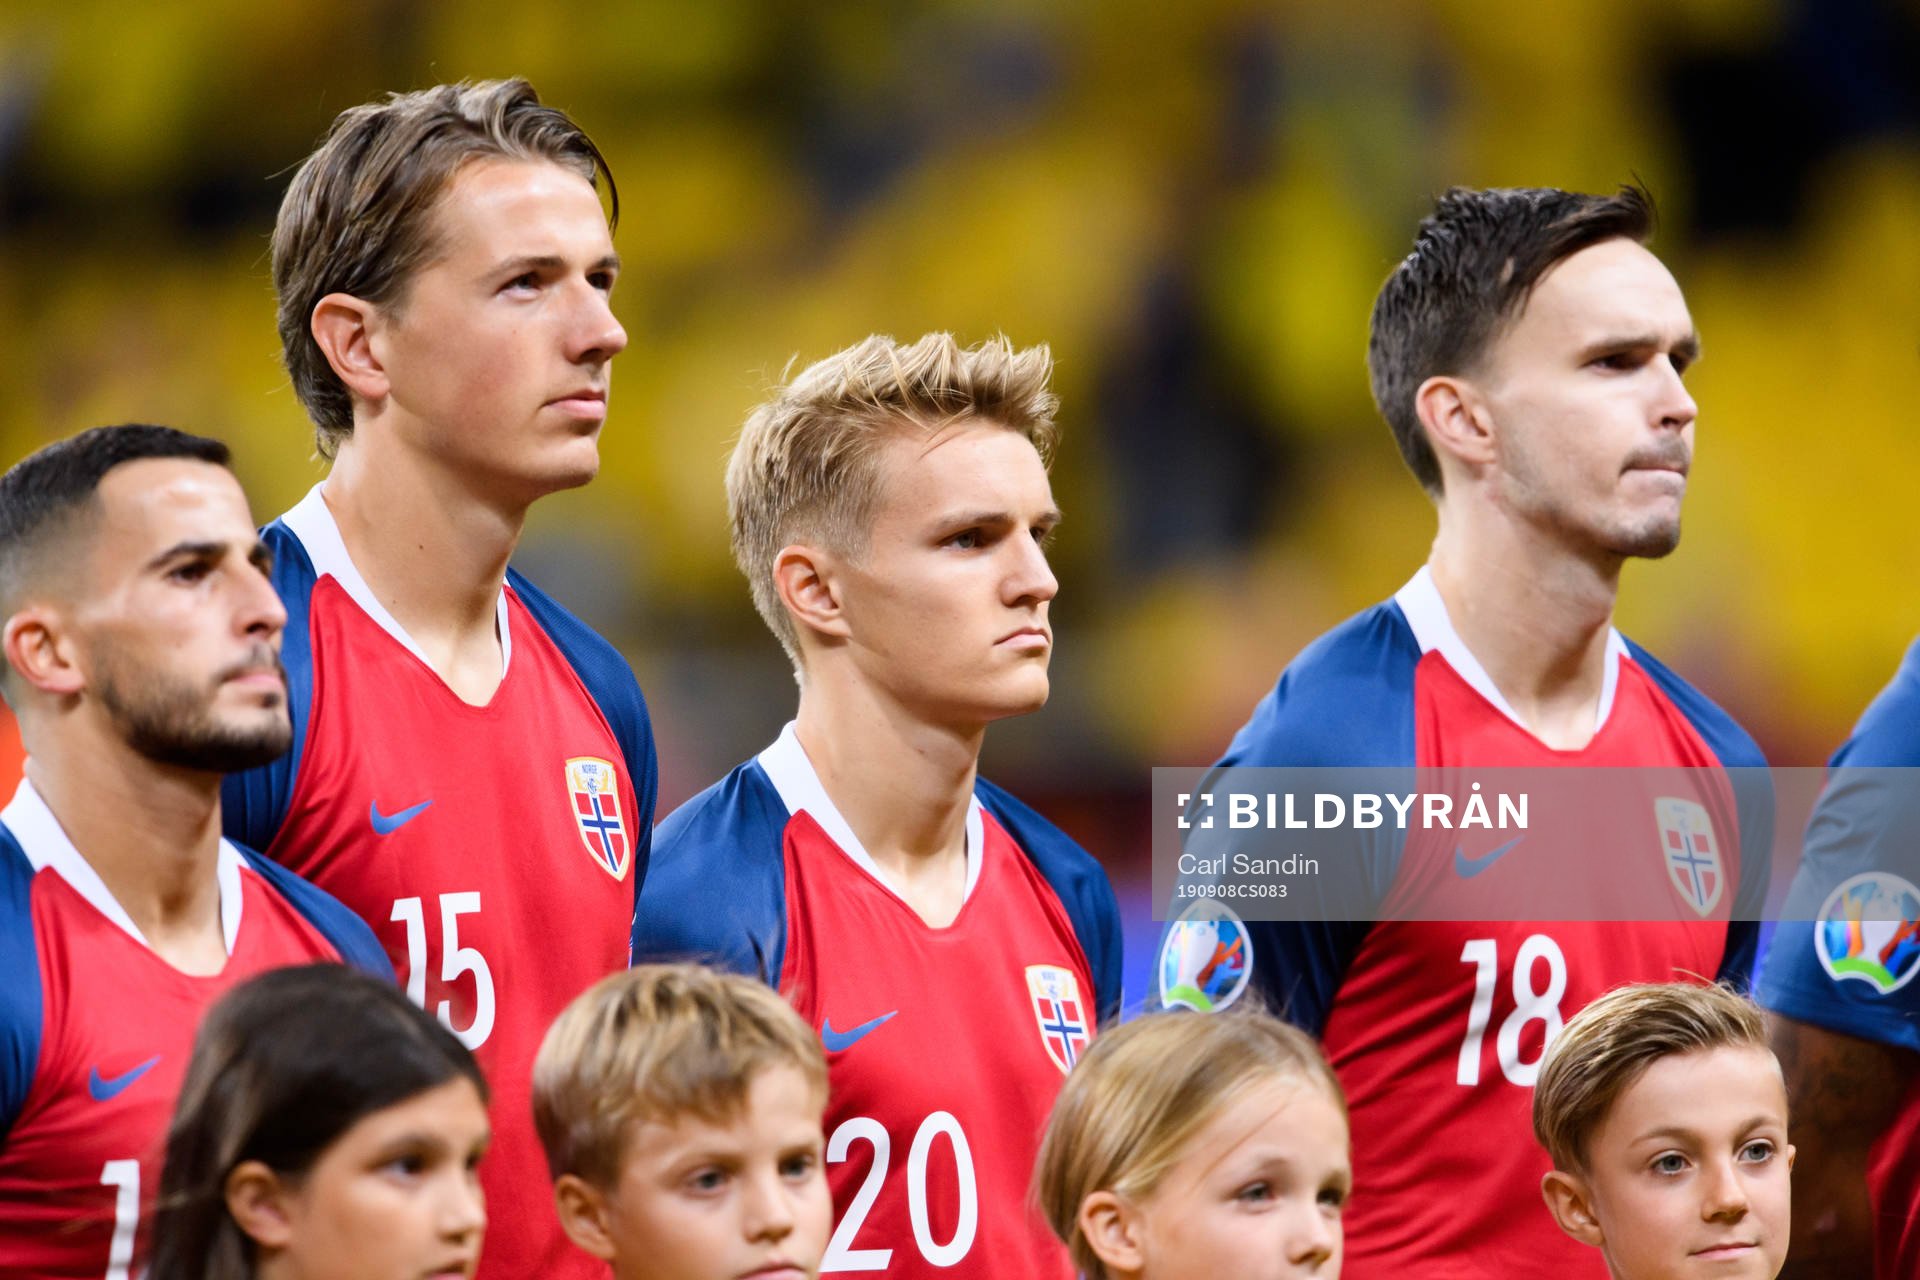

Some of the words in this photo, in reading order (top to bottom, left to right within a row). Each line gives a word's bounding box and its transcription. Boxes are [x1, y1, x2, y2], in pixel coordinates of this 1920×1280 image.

[390, 891, 496, 1051] 15
[1456, 933, 1567, 1087] 18
[100, 1159, 150, 1280] 1
[818, 1110, 978, 1272] 20
